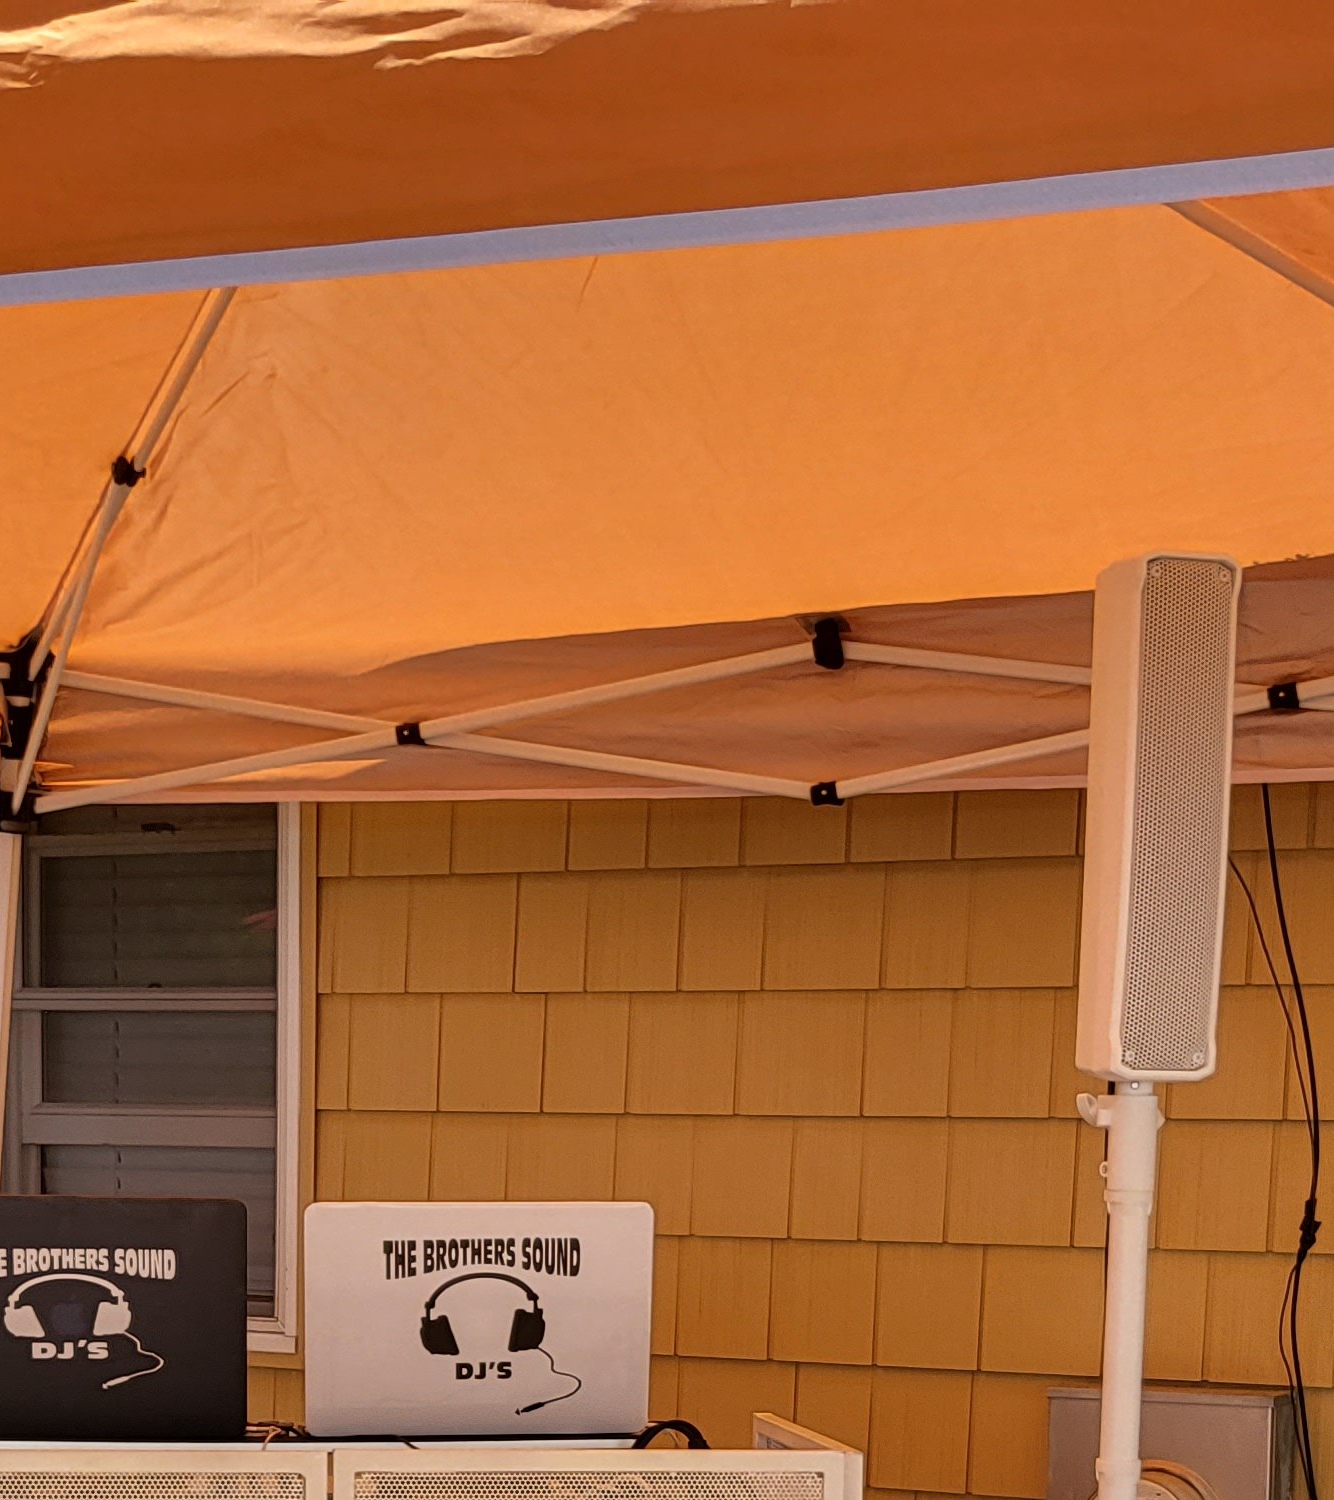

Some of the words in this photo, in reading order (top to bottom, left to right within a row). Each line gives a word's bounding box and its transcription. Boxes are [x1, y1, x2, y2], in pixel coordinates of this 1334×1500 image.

[12, 1247, 110, 1275] BROTHERS
[114, 1248, 176, 1280] SOUND
[382, 1239, 417, 1280] THE
[423, 1237, 516, 1274] BROTHERS
[521, 1236, 581, 1277] SOUND
[31, 1339, 109, 1359] DJ'S
[455, 1361, 513, 1380] DJ'S
